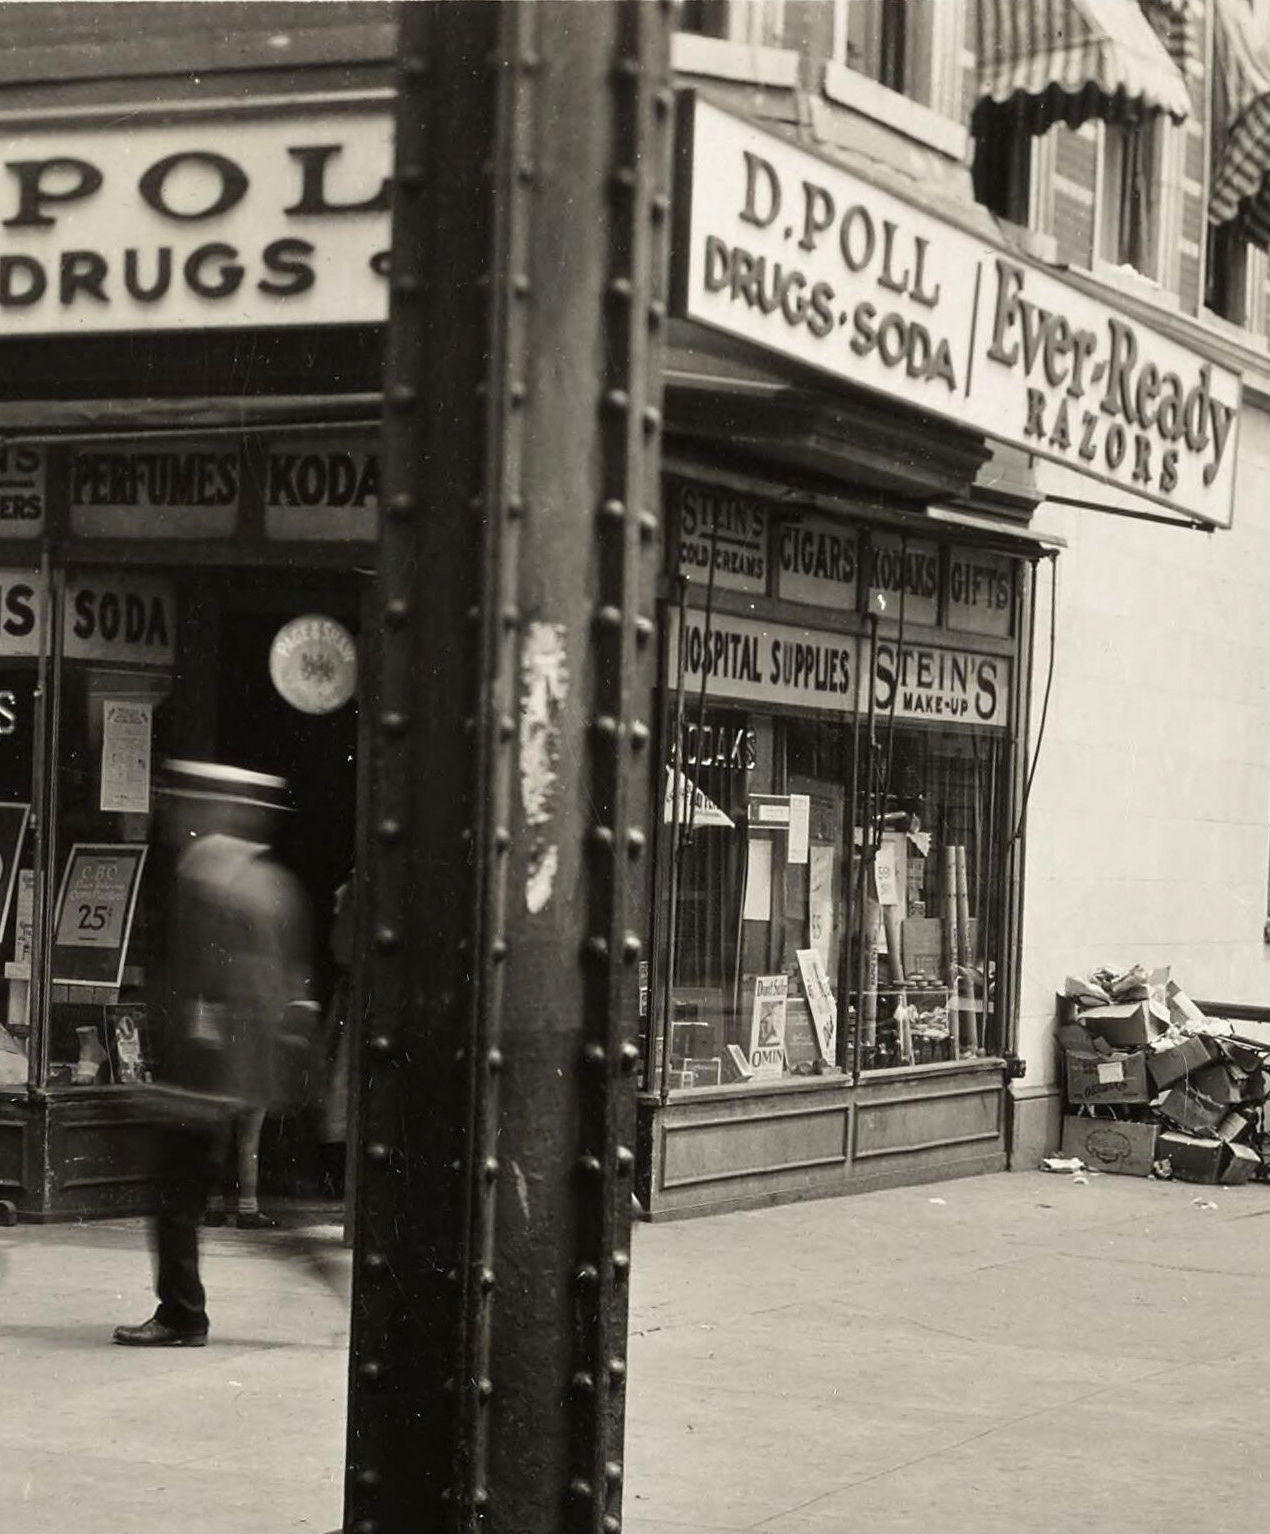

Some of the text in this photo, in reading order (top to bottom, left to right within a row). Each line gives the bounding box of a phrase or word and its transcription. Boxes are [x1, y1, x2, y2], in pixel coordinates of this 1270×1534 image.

[986, 259, 1235, 488] Ever-Ready
[1026, 387, 1180, 494] RAZORS
[73, 453, 239, 507] PERFUMES
[781, 525, 856, 584] CIGARS
[950, 560, 1009, 610] GIFTS
[73, 588, 169, 647] SODA
[770, 639, 850, 695] SUPPLIES
[875, 644, 998, 721] STEIN'S
